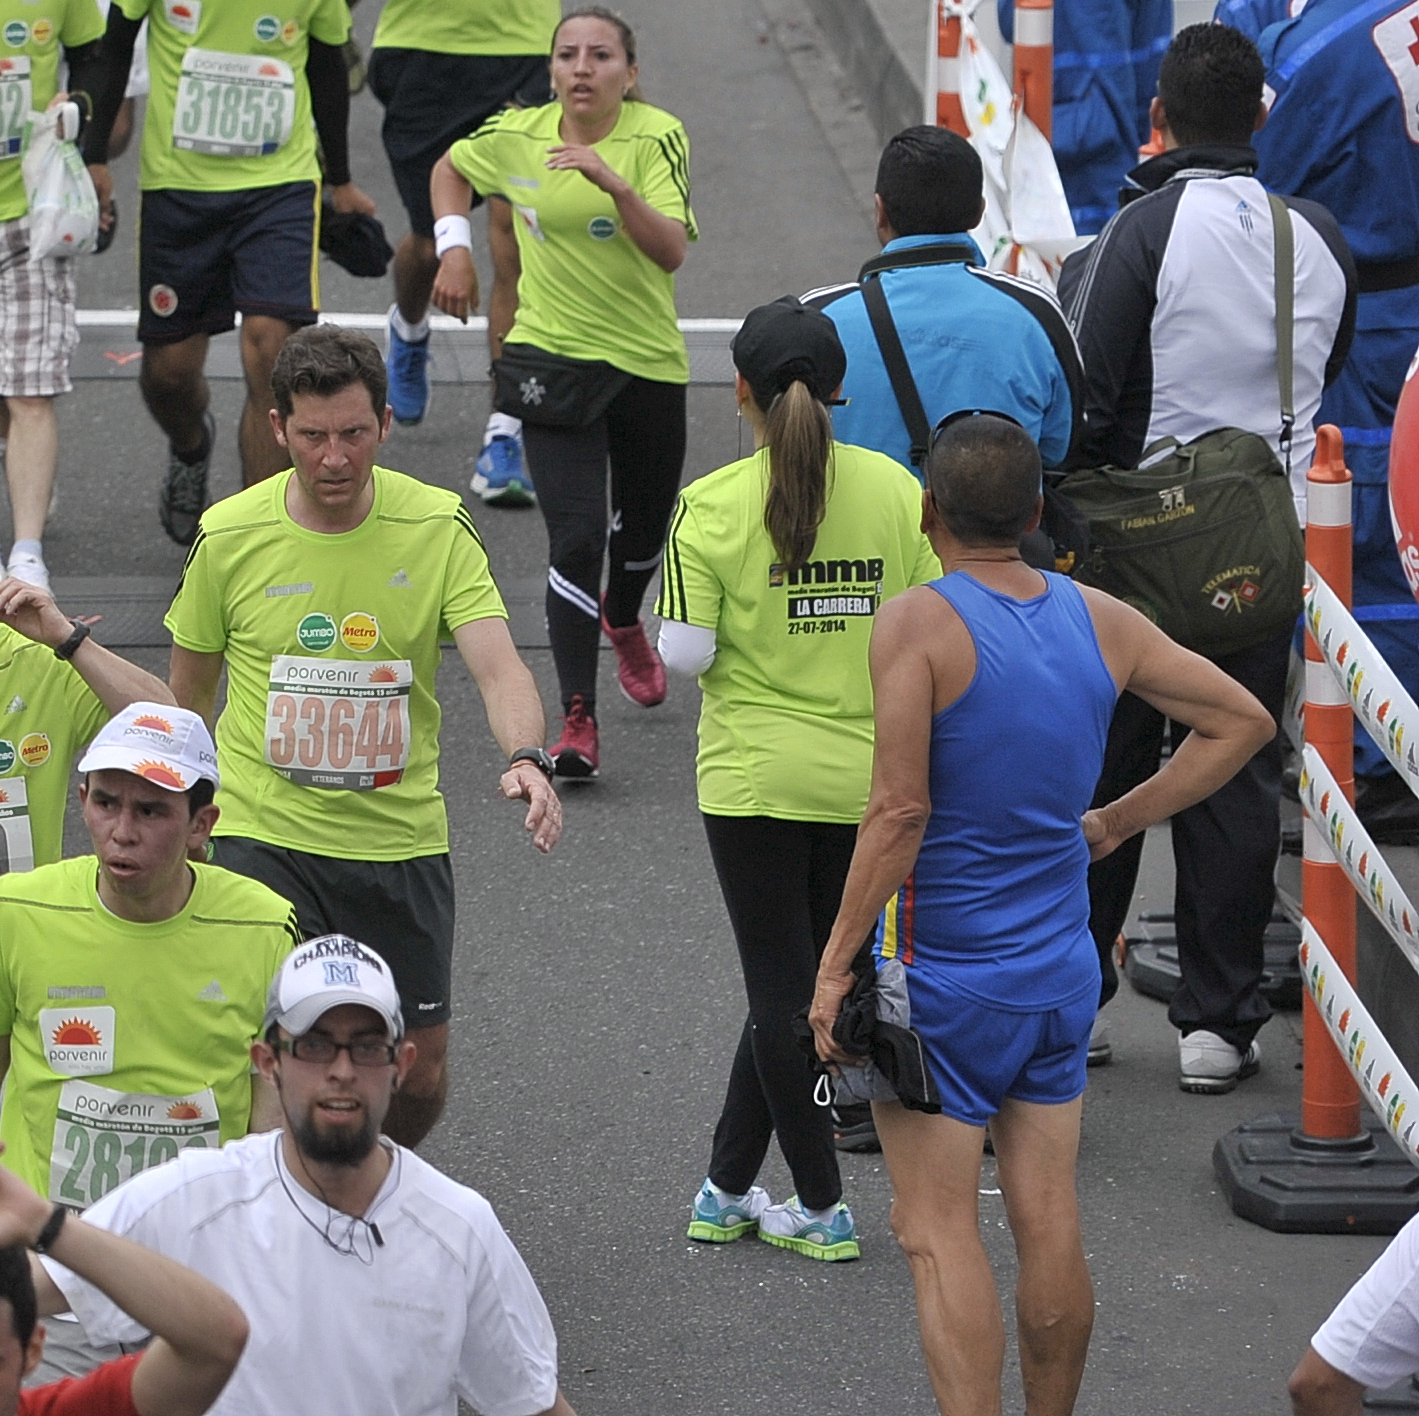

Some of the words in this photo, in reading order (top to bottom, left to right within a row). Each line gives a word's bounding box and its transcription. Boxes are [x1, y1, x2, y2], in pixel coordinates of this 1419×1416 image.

[182, 78, 286, 141] 31853
[796, 599, 811, 617] LA
[813, 597, 872, 616] CARRERA
[299, 627, 334, 638] JUMBO
[343, 625, 377, 638] Metro
[787, 619, 847, 635] 27-07-2014
[285, 664, 360, 683] porvenir
[123, 726, 175, 746] porvenir
[270, 694, 404, 769] 33644
[21, 743, 50, 756] Metro
[49, 1048, 108, 1064] porvenir
[75, 1093, 155, 1118] porvenir
